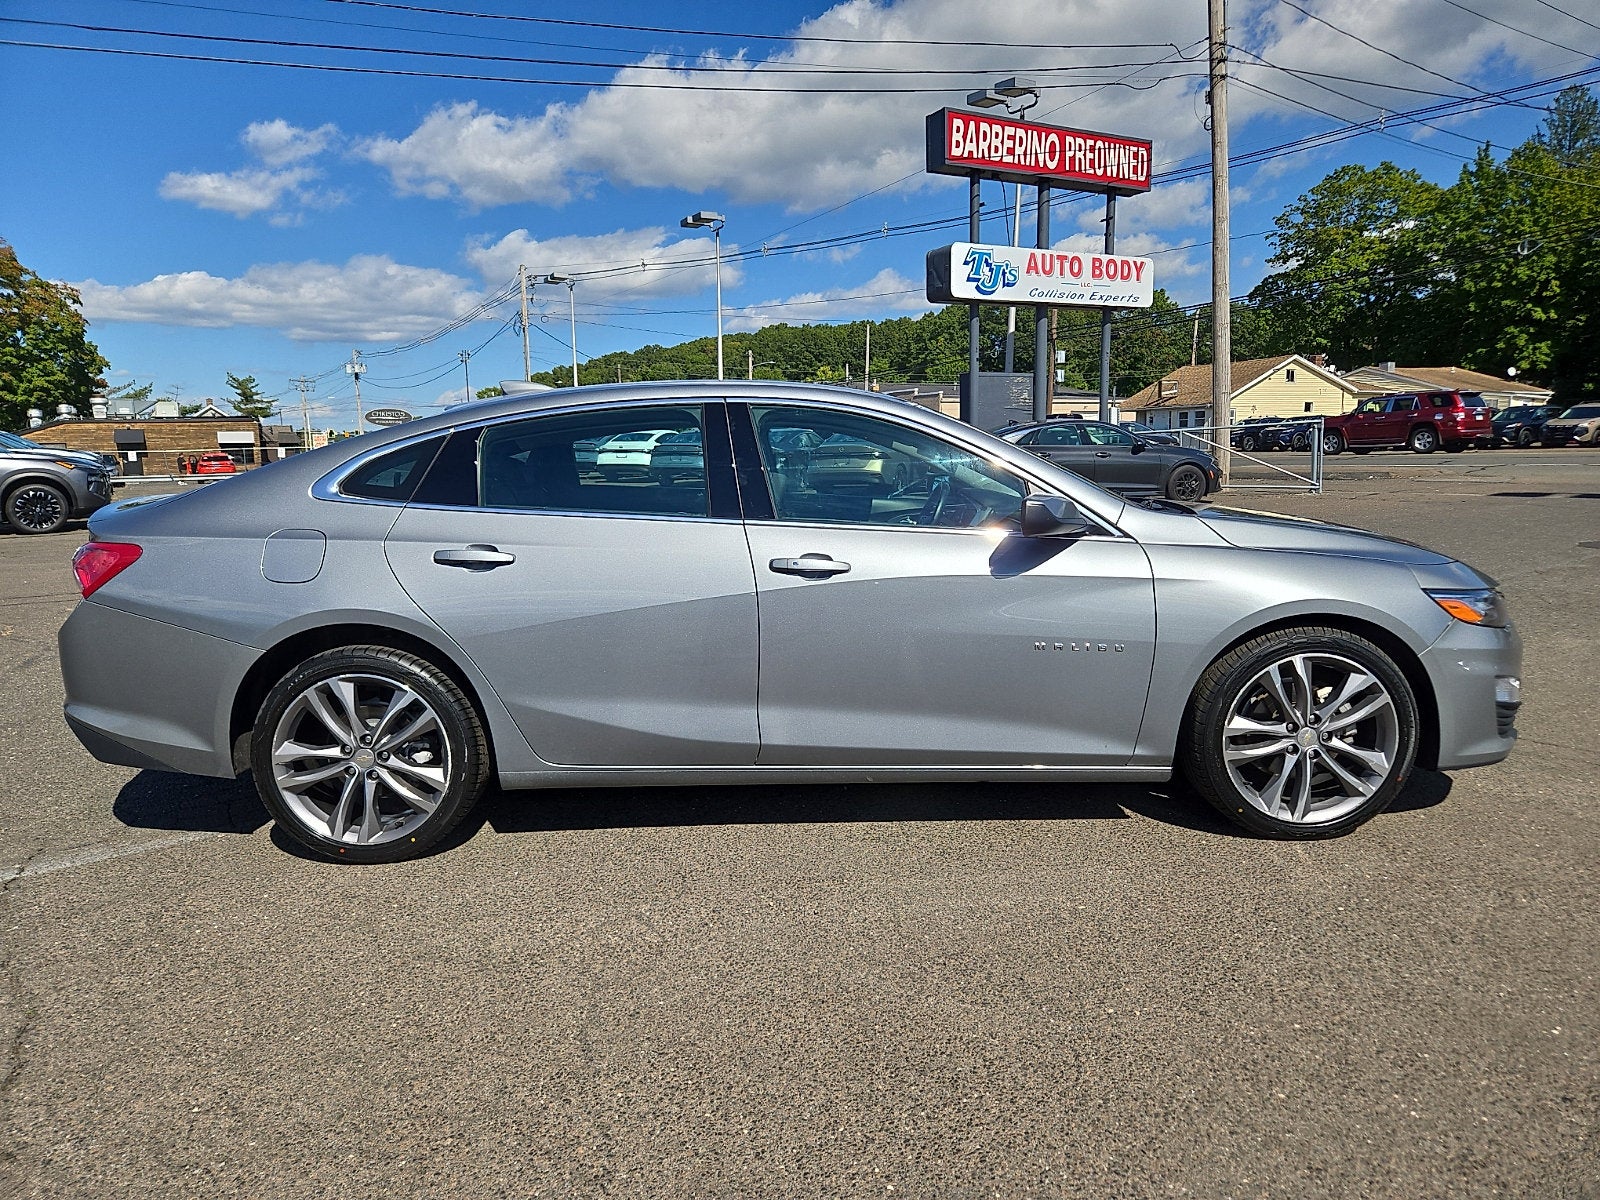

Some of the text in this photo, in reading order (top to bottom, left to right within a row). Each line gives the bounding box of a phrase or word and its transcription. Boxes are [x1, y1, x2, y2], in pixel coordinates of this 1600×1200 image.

[950, 118, 1148, 182] BARBERINO PREOWNED
[1025, 252, 1146, 282] AUTO BODY
[1028, 287, 1140, 303] Collision Experts
[1034, 641, 1124, 652] MALIBU
